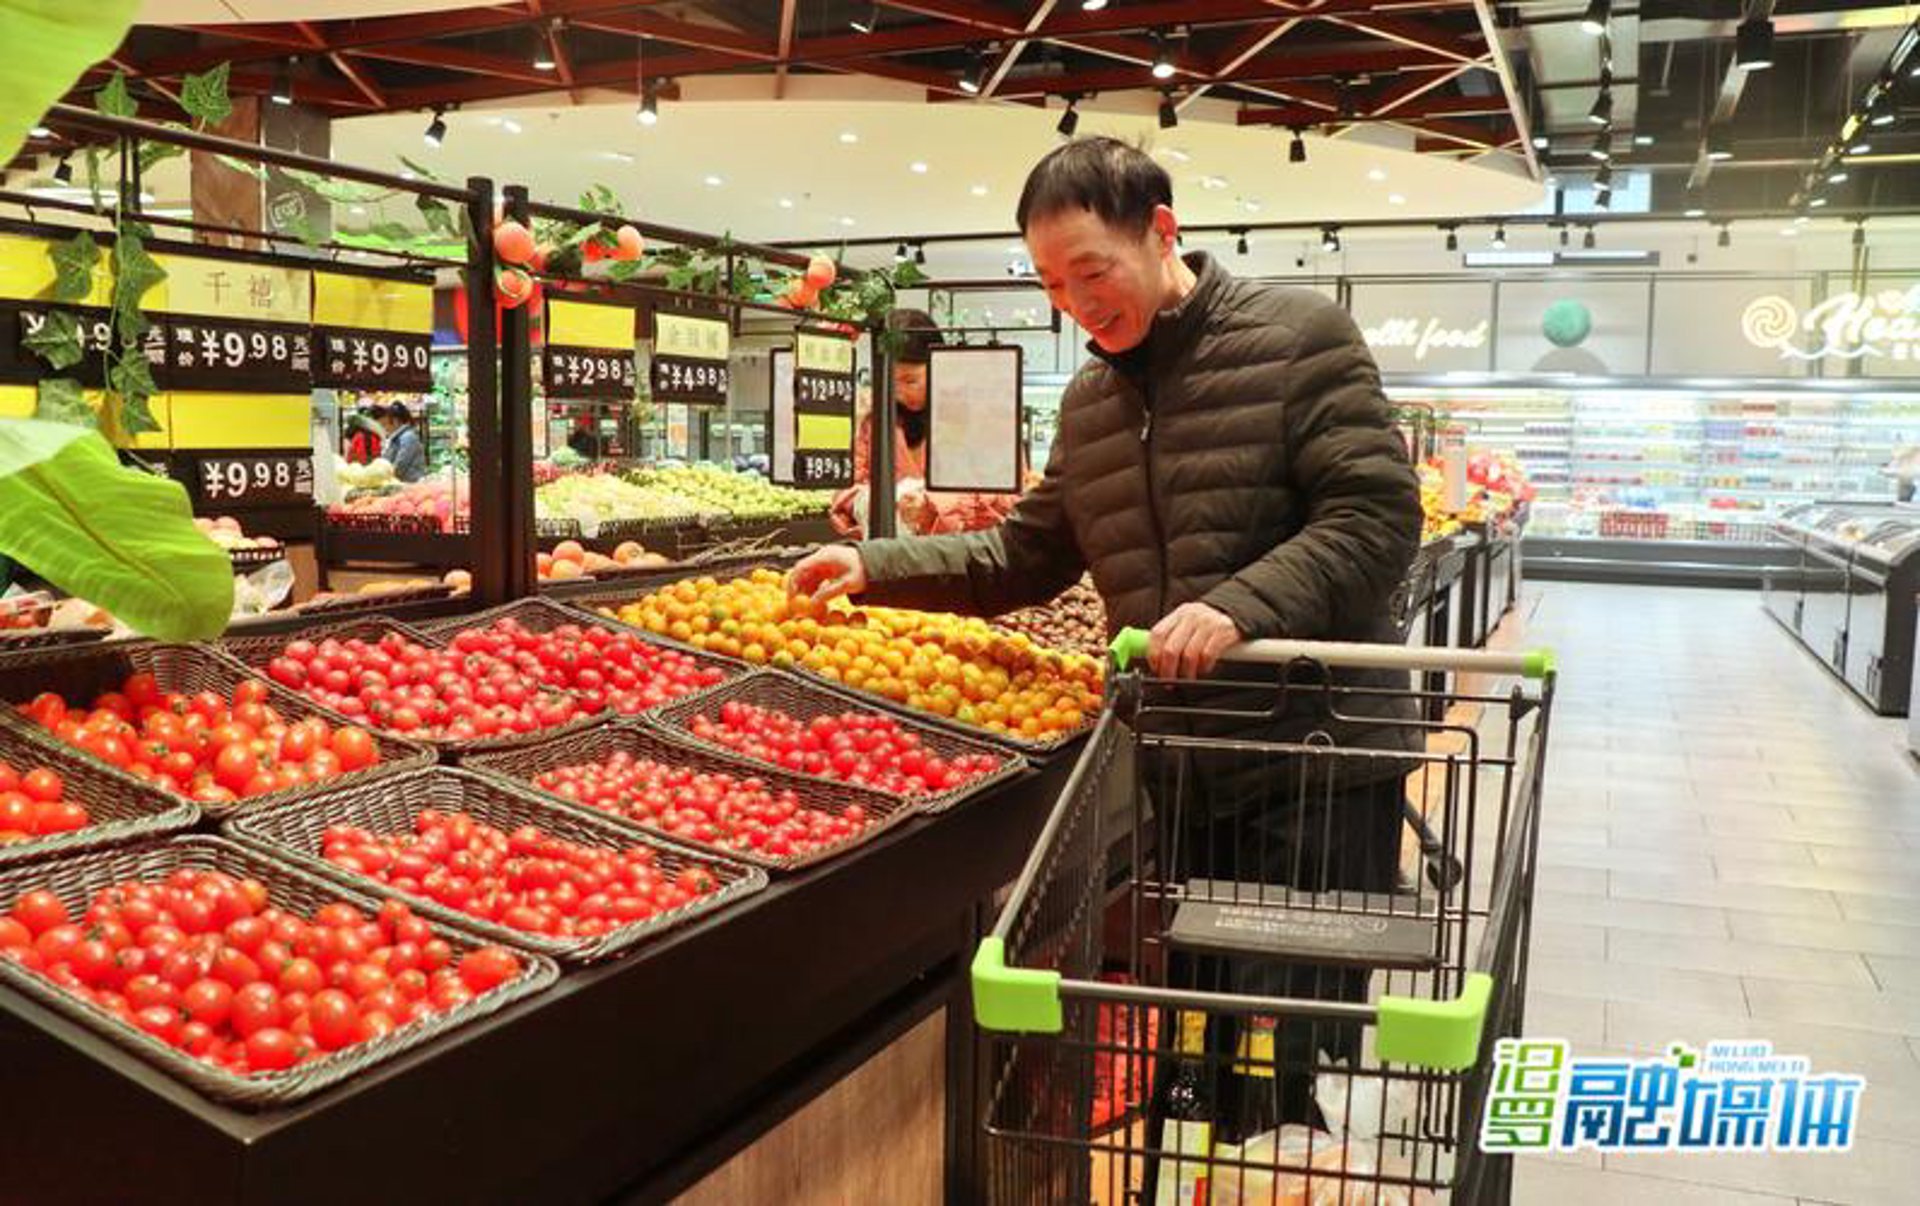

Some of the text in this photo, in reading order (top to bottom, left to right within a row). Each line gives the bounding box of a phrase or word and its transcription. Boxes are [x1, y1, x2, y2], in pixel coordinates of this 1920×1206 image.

[201, 330, 287, 367] ¥9.98
[353, 339, 428, 374] ¥9.90
[1415, 318, 1488, 360] food
[205, 462, 290, 498] ¥9.98
